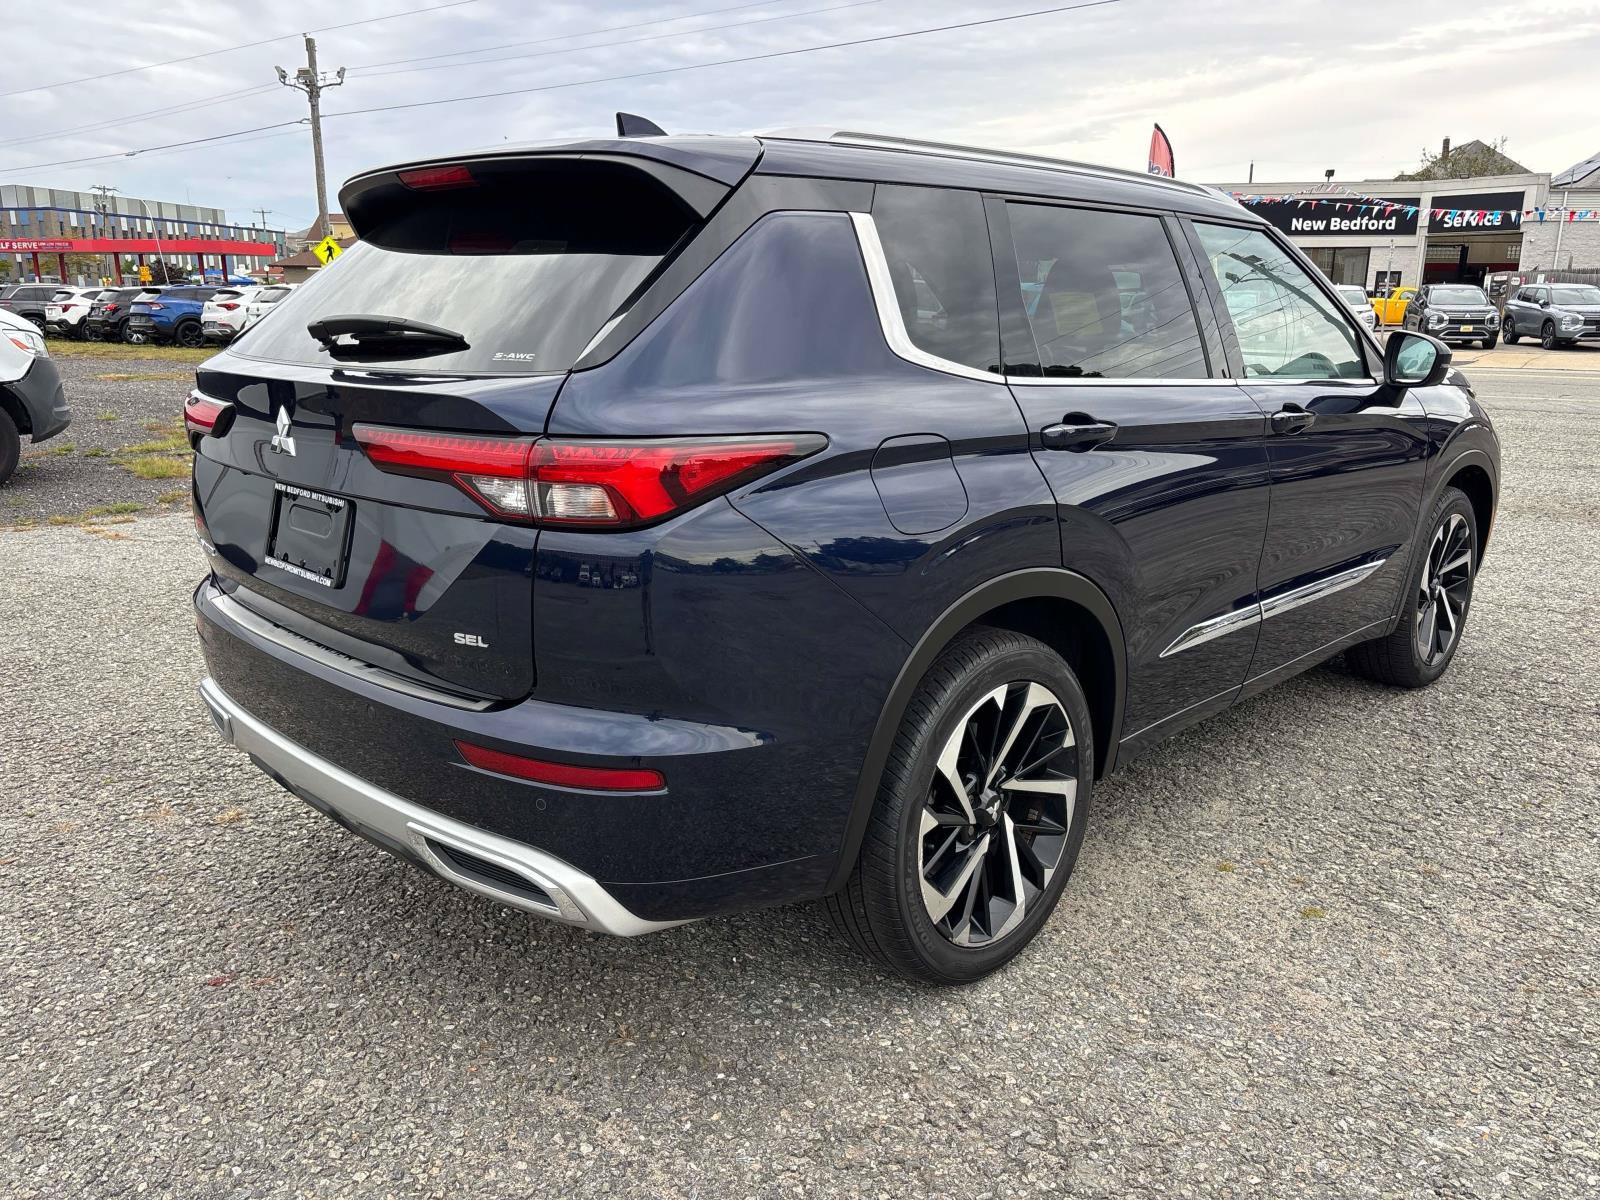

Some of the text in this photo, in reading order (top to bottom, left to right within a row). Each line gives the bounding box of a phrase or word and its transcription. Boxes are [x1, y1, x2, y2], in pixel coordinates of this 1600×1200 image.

[1291, 215, 1397, 231] New Bedford
[1443, 211, 1502, 228] Service
[12, 241, 38, 250] SERVE
[494, 352, 536, 360] S-AWC
[274, 482, 345, 508] NEW BEDFORD MITSUBISHI
[453, 632, 490, 648] SEL
